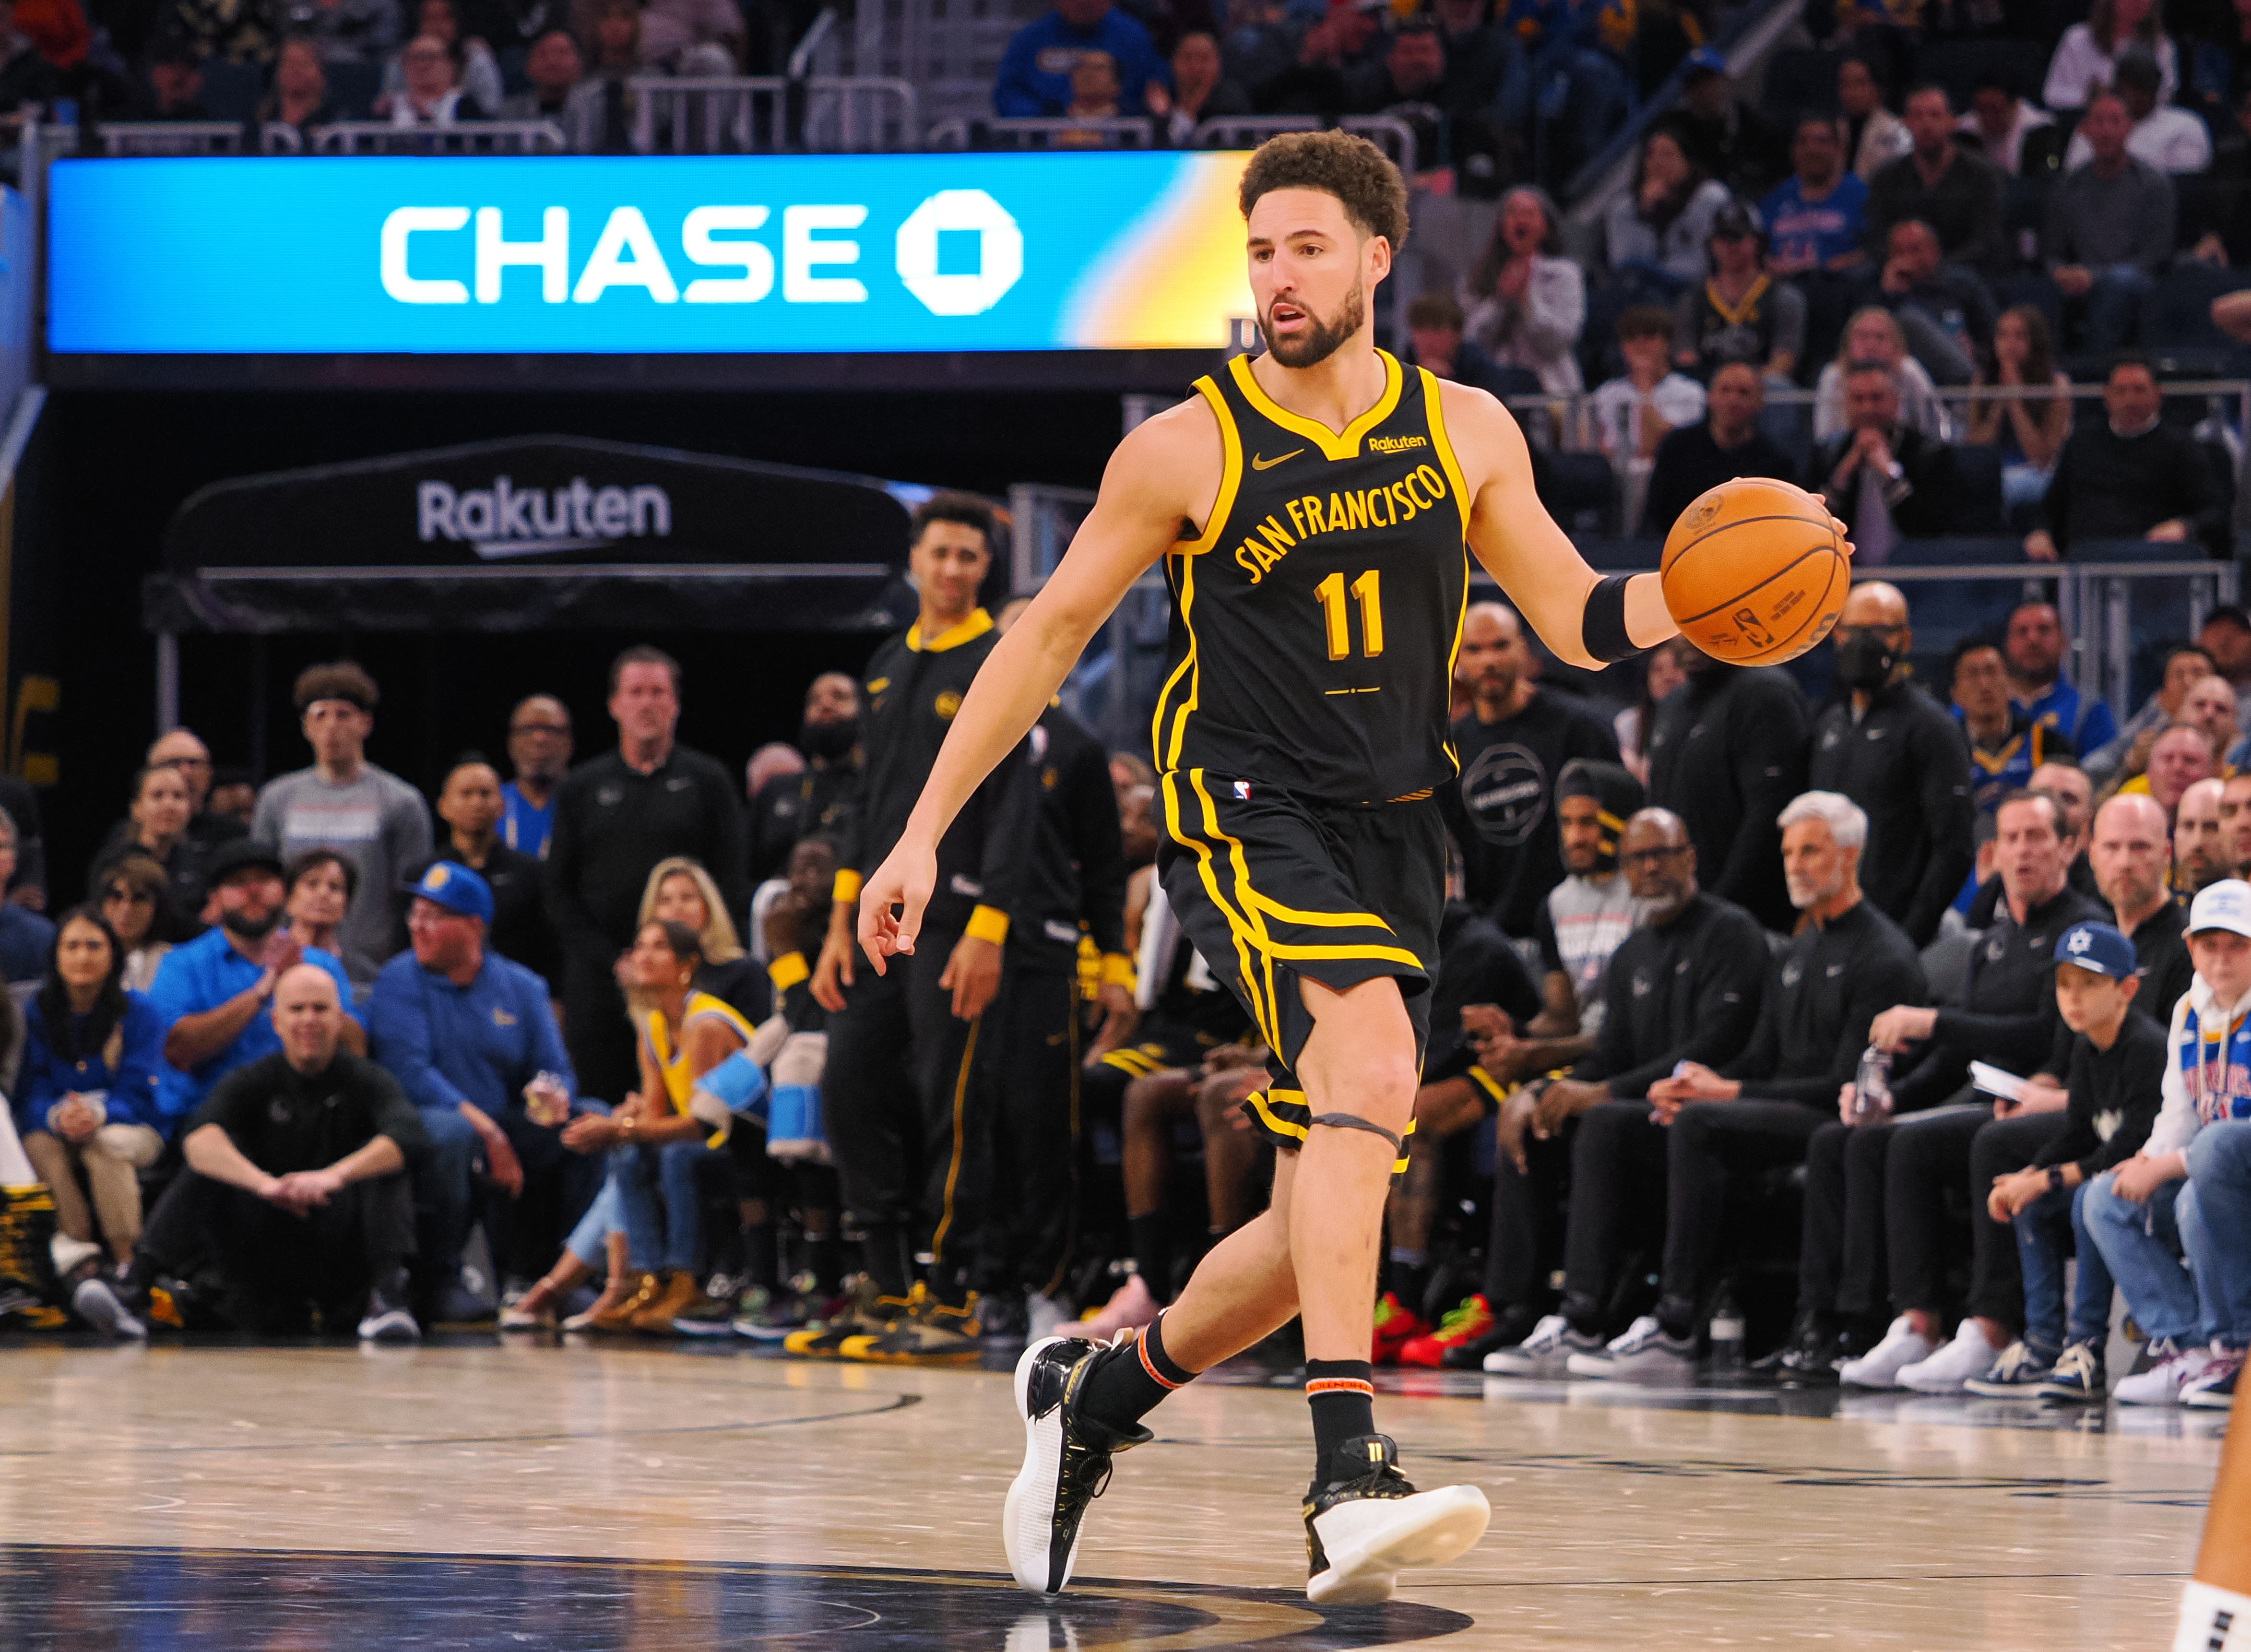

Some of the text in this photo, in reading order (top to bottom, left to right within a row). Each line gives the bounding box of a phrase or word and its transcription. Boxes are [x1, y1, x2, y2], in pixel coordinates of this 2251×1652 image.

[380, 204, 869, 304] CHASE
[1368, 436, 1427, 451] Rakuten
[417, 474, 671, 543] Rakuten
[1235, 464, 1446, 584] SAN FRANCISCO
[1314, 570, 1383, 661] 11
